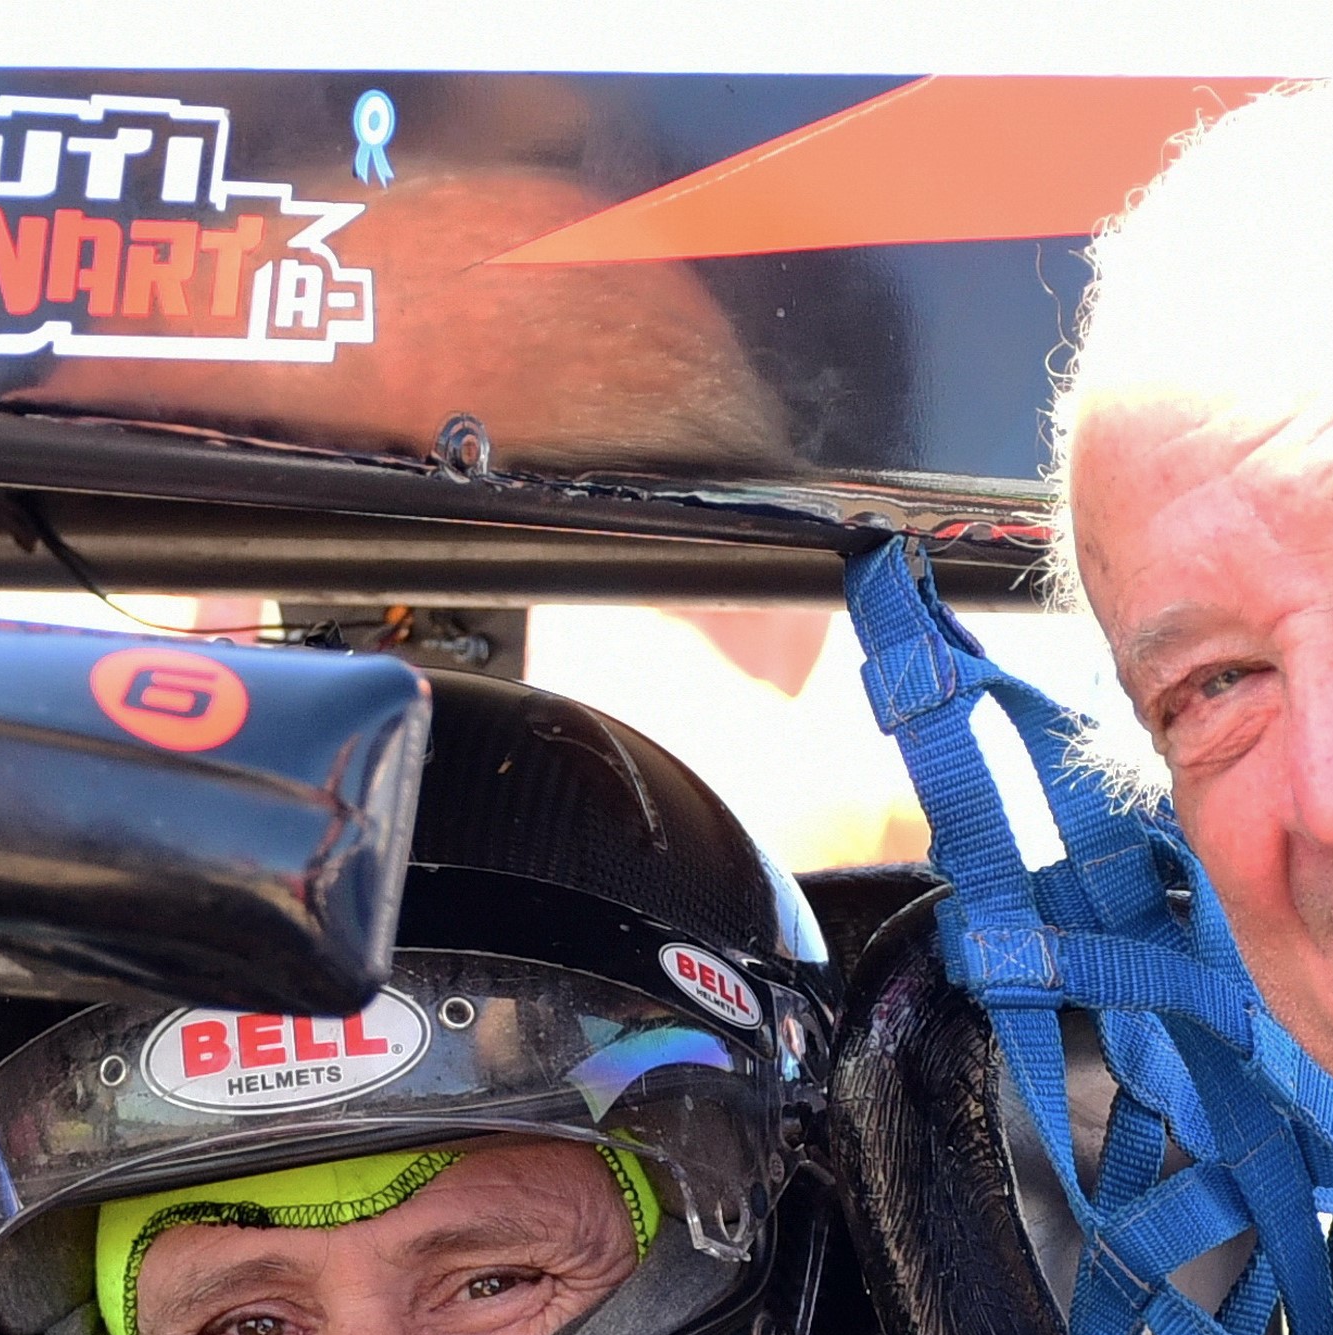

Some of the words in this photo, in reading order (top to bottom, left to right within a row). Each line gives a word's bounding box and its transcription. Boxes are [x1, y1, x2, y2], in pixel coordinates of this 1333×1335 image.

[675, 951, 750, 1015] BELL
[695, 986, 736, 1017] HELMETS
[181, 1010, 388, 1078] BELL
[227, 1065, 343, 1096] HELMETS
